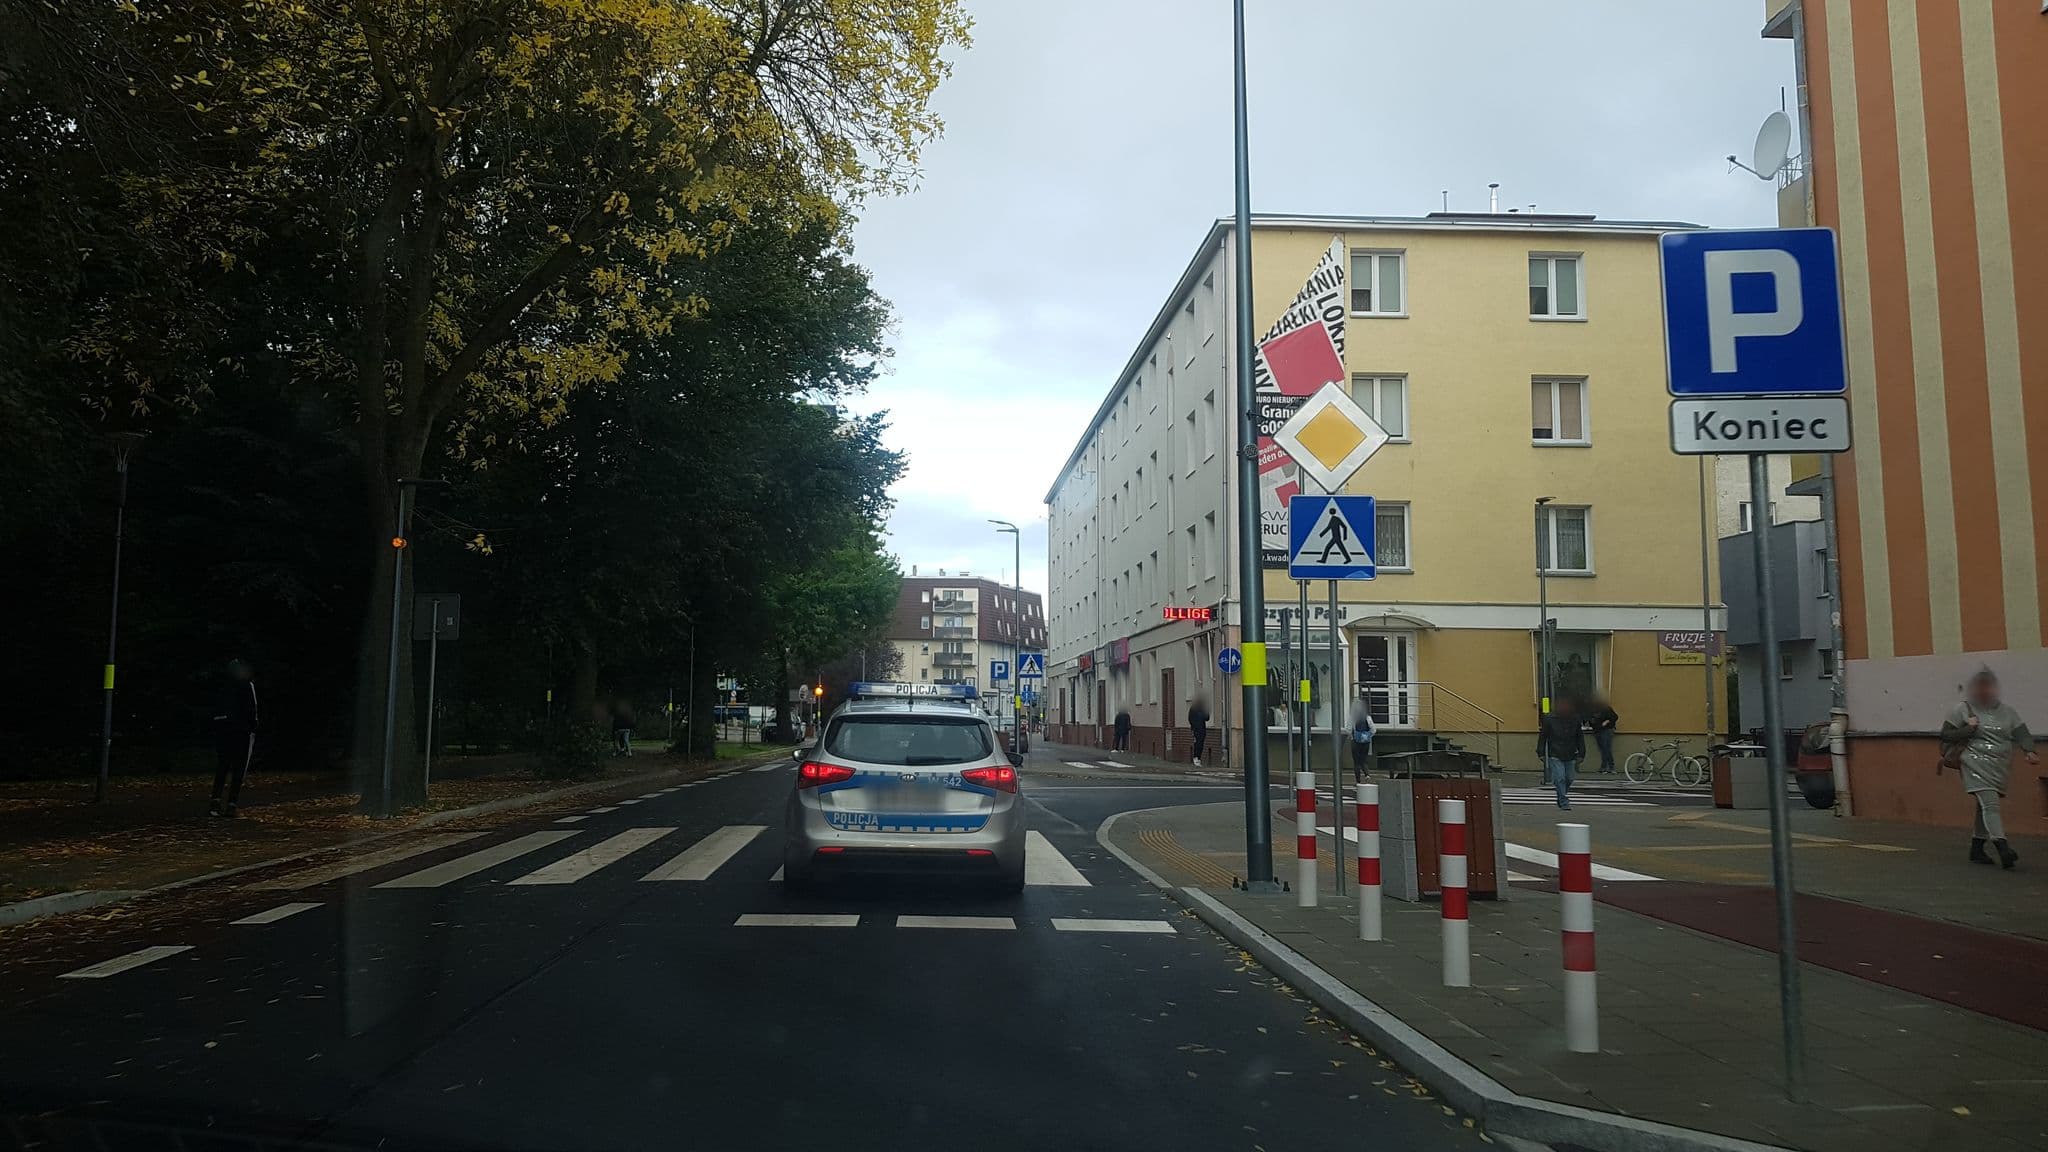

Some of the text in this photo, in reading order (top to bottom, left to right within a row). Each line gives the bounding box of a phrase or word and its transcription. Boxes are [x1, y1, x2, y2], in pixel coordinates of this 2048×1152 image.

[1704, 249, 1804, 374] P
[1693, 409, 1829, 441] Koniec
[994, 662, 1006, 678] P
[896, 684, 938, 696] POLICJA
[833, 812, 879, 826] POLICJA
